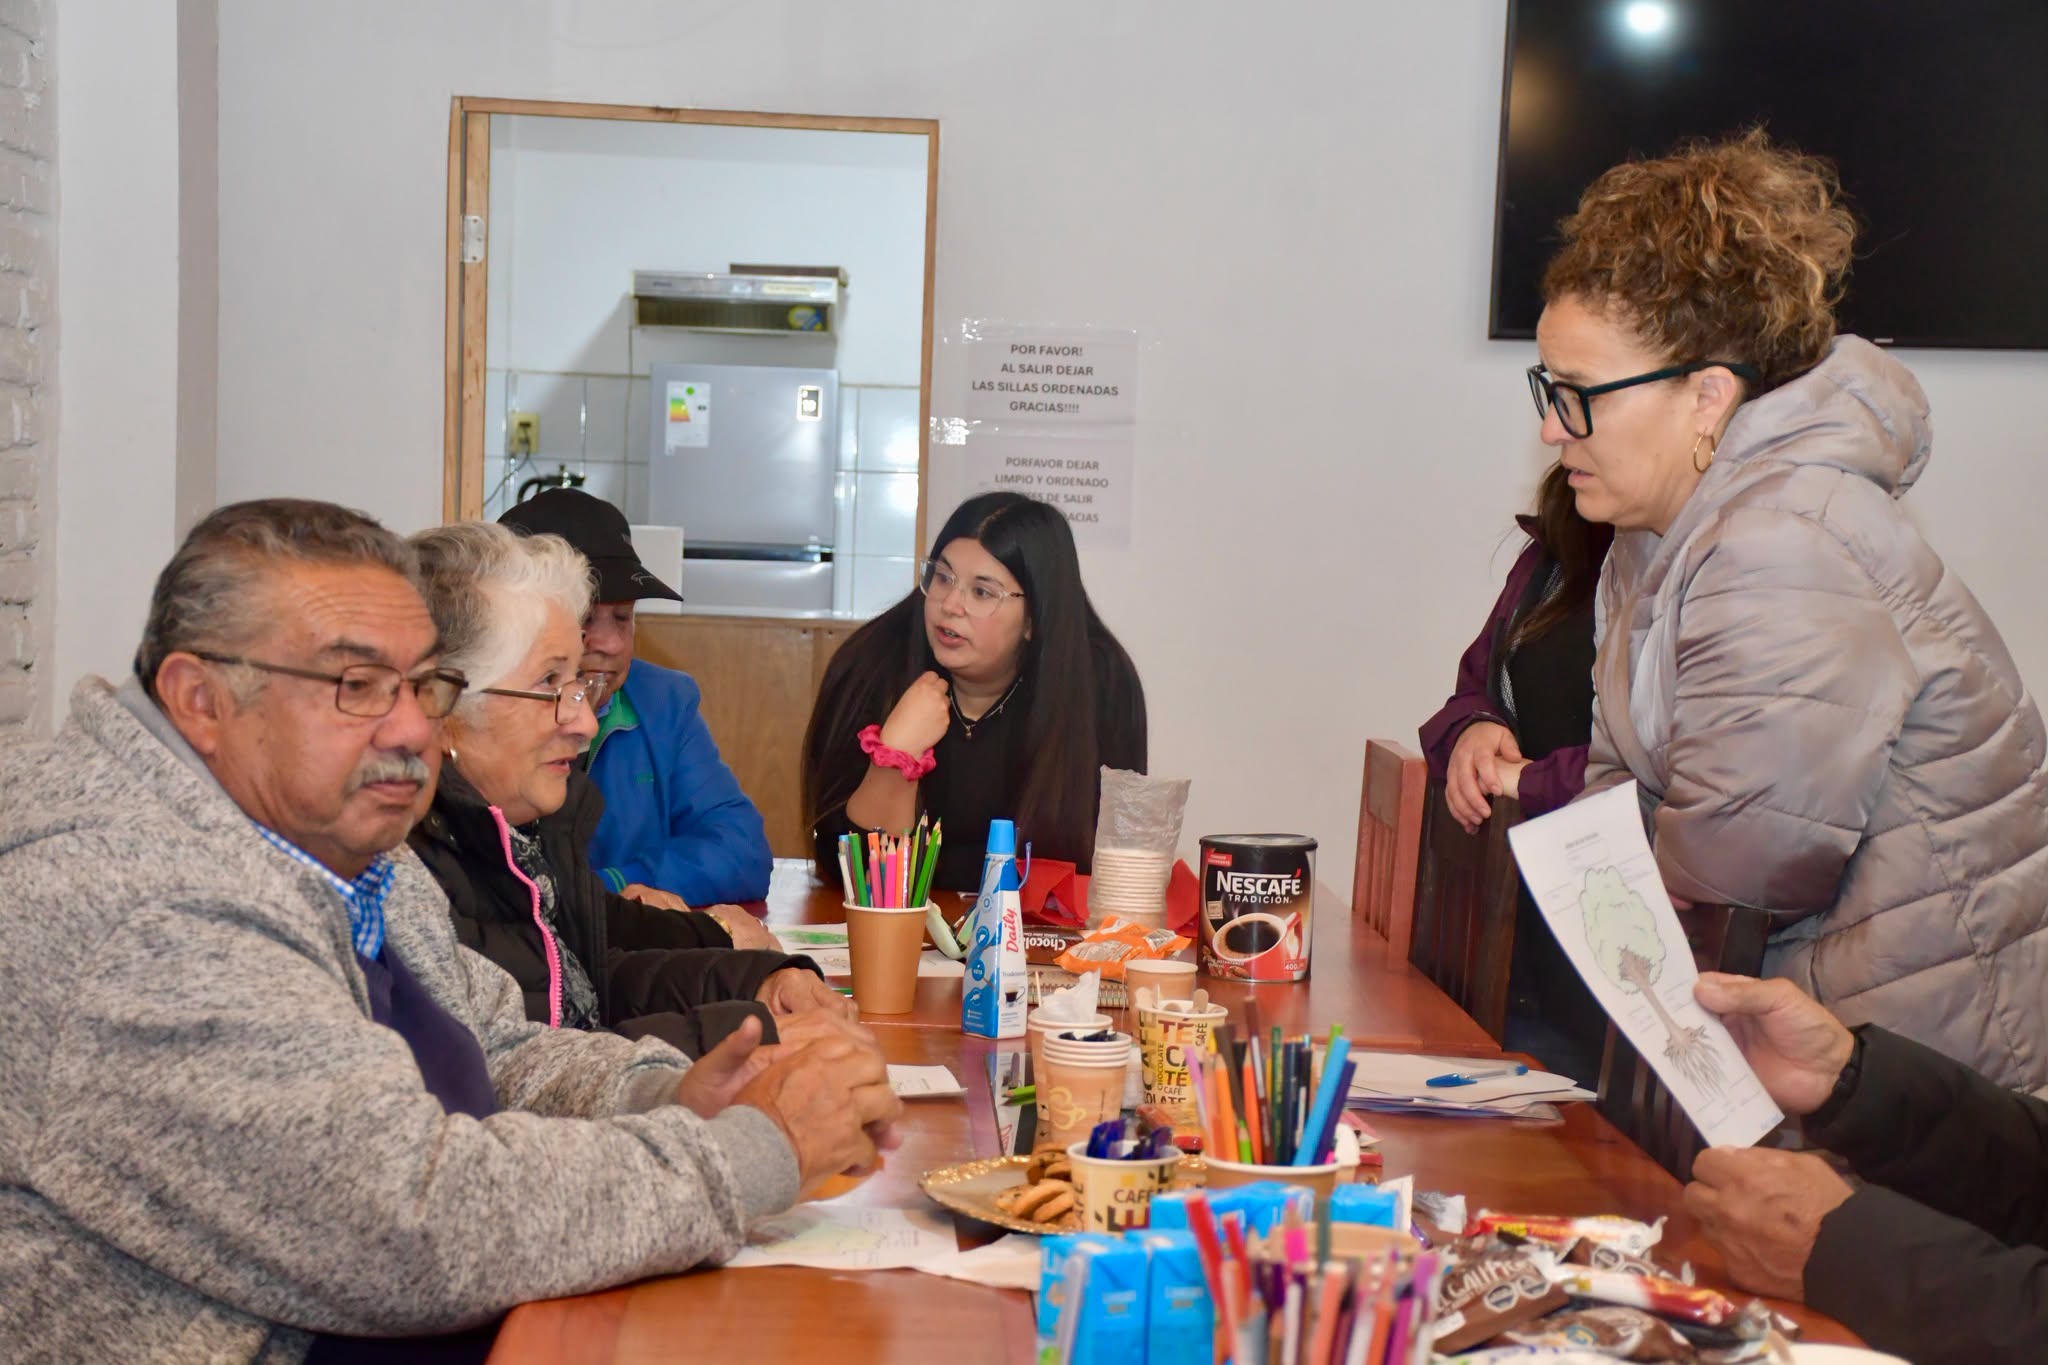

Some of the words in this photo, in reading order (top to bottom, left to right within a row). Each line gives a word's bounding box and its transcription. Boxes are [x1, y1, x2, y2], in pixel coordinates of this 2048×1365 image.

[1010, 344, 1036, 355] POR
[1039, 345, 1083, 356] FAVOR!
[1001, 364, 1016, 374] AL
[1019, 364, 1053, 375] SALIR
[1056, 365, 1094, 376] DEJAR
[972, 381, 994, 391] LAS
[997, 382, 1039, 393] SILLAS
[1041, 384, 1119, 396] ORDENADAS
[1009, 401, 1080, 413] GRACIAS!!!!
[1006, 457, 1063, 469] PORFAVOR
[1066, 459, 1099, 470] DEJAR
[995, 474, 1034, 485] LIMPIO
[1036, 475, 1044, 484] Y
[1046, 476, 1109, 488] ORDENADO
[1046, 492, 1061, 502] DE
[1063, 494, 1093, 504] SALIR
[1003, 908, 1019, 953] Daily
[1164, 1068, 1188, 1087] TÉ
